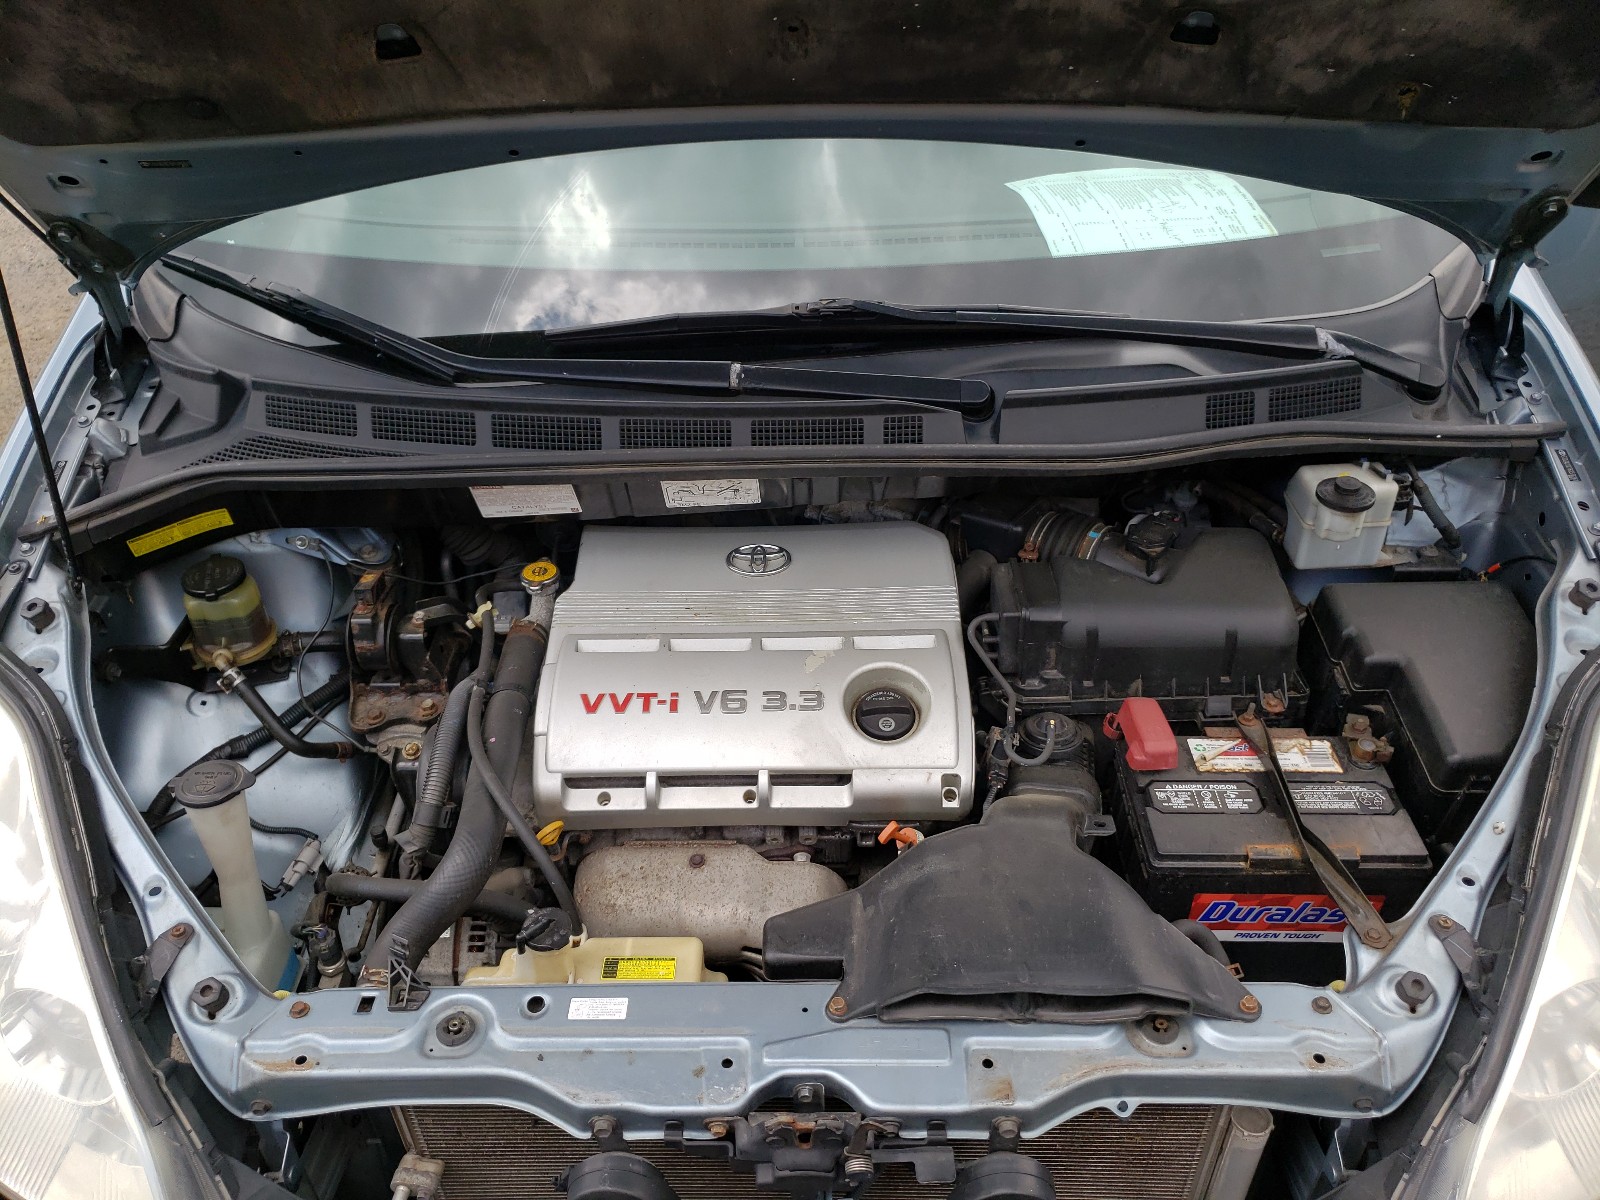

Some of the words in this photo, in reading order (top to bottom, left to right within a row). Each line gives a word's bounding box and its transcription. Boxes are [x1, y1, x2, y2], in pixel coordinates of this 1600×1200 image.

[580, 692, 679, 714] VVT-i
[693, 689, 747, 714] V6
[761, 690, 825, 712] 3.3
[1197, 900, 1349, 924] Duralas
